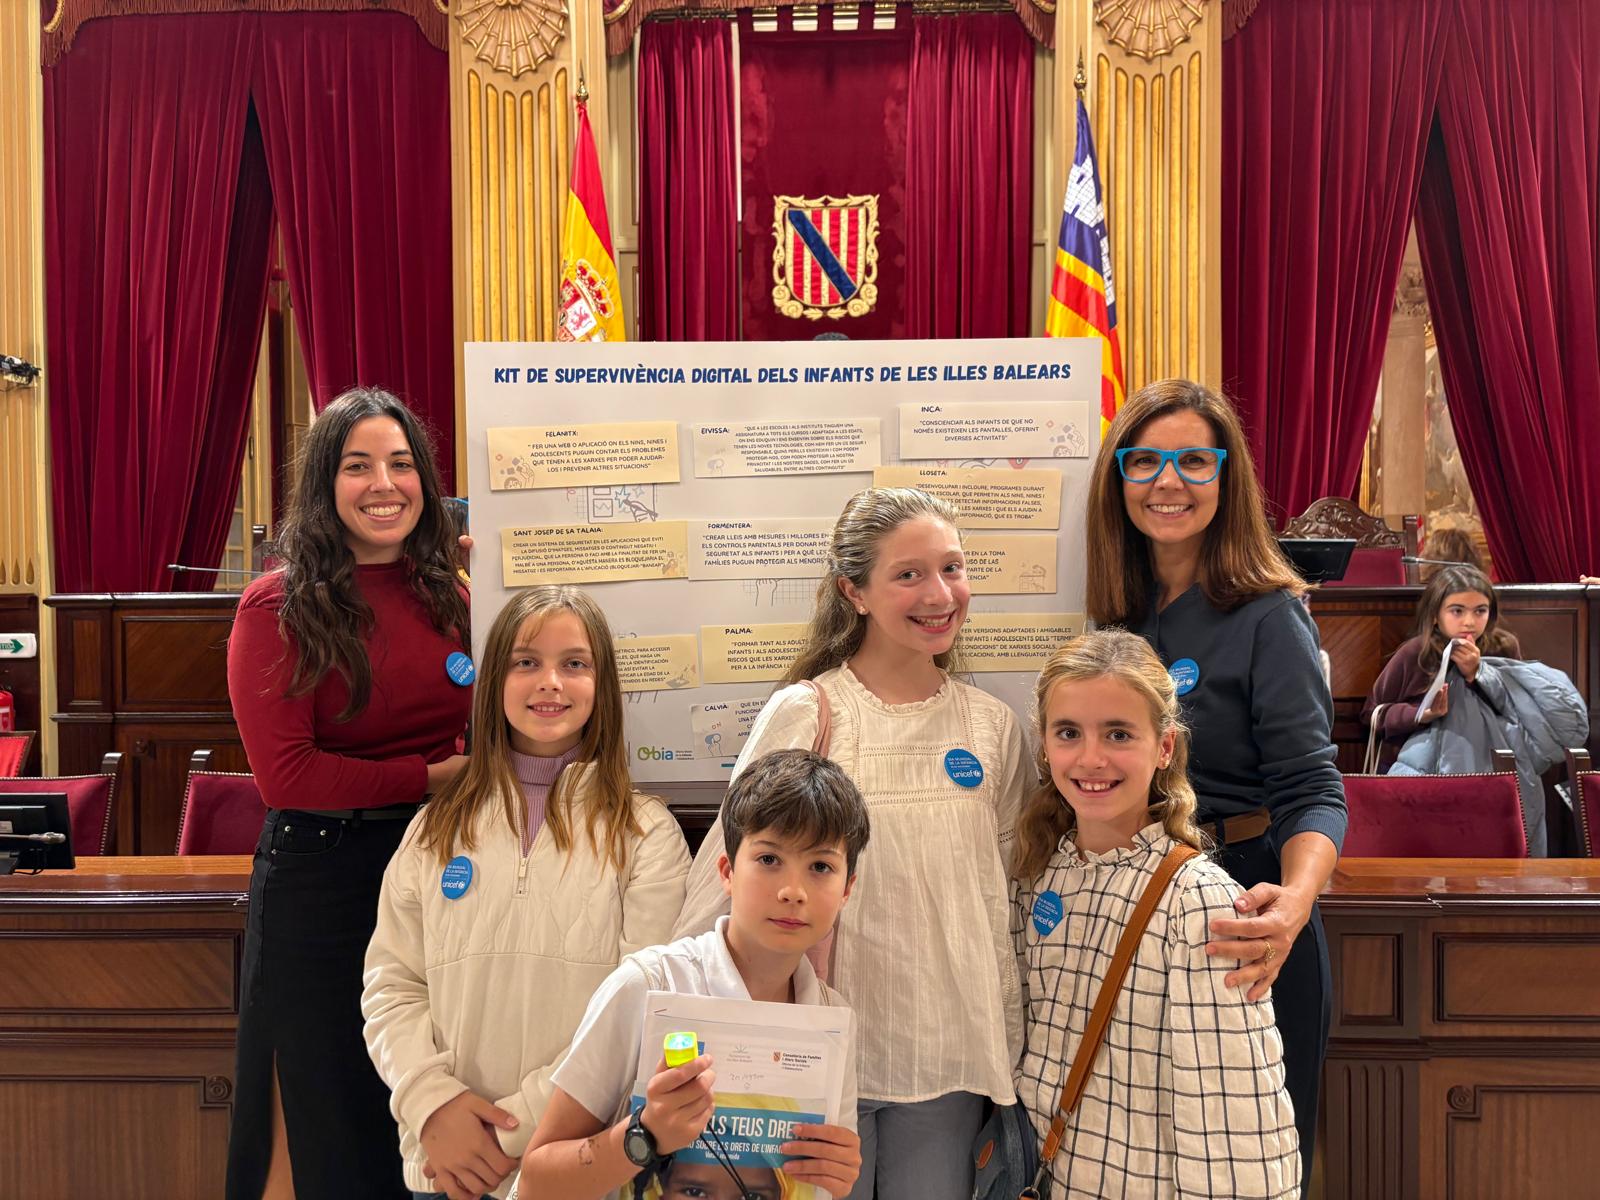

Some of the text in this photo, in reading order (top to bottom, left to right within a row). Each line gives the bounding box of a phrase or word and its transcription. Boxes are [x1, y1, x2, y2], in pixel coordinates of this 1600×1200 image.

[494, 363, 1070, 383] KIT DE SUPERVIVÈNCIA DIGITAL DELS INFANTS DE LES ILLES BALEARS
[578, 439, 608, 447] APLICACIÓ
[731, 1116, 764, 1136] TEUS
